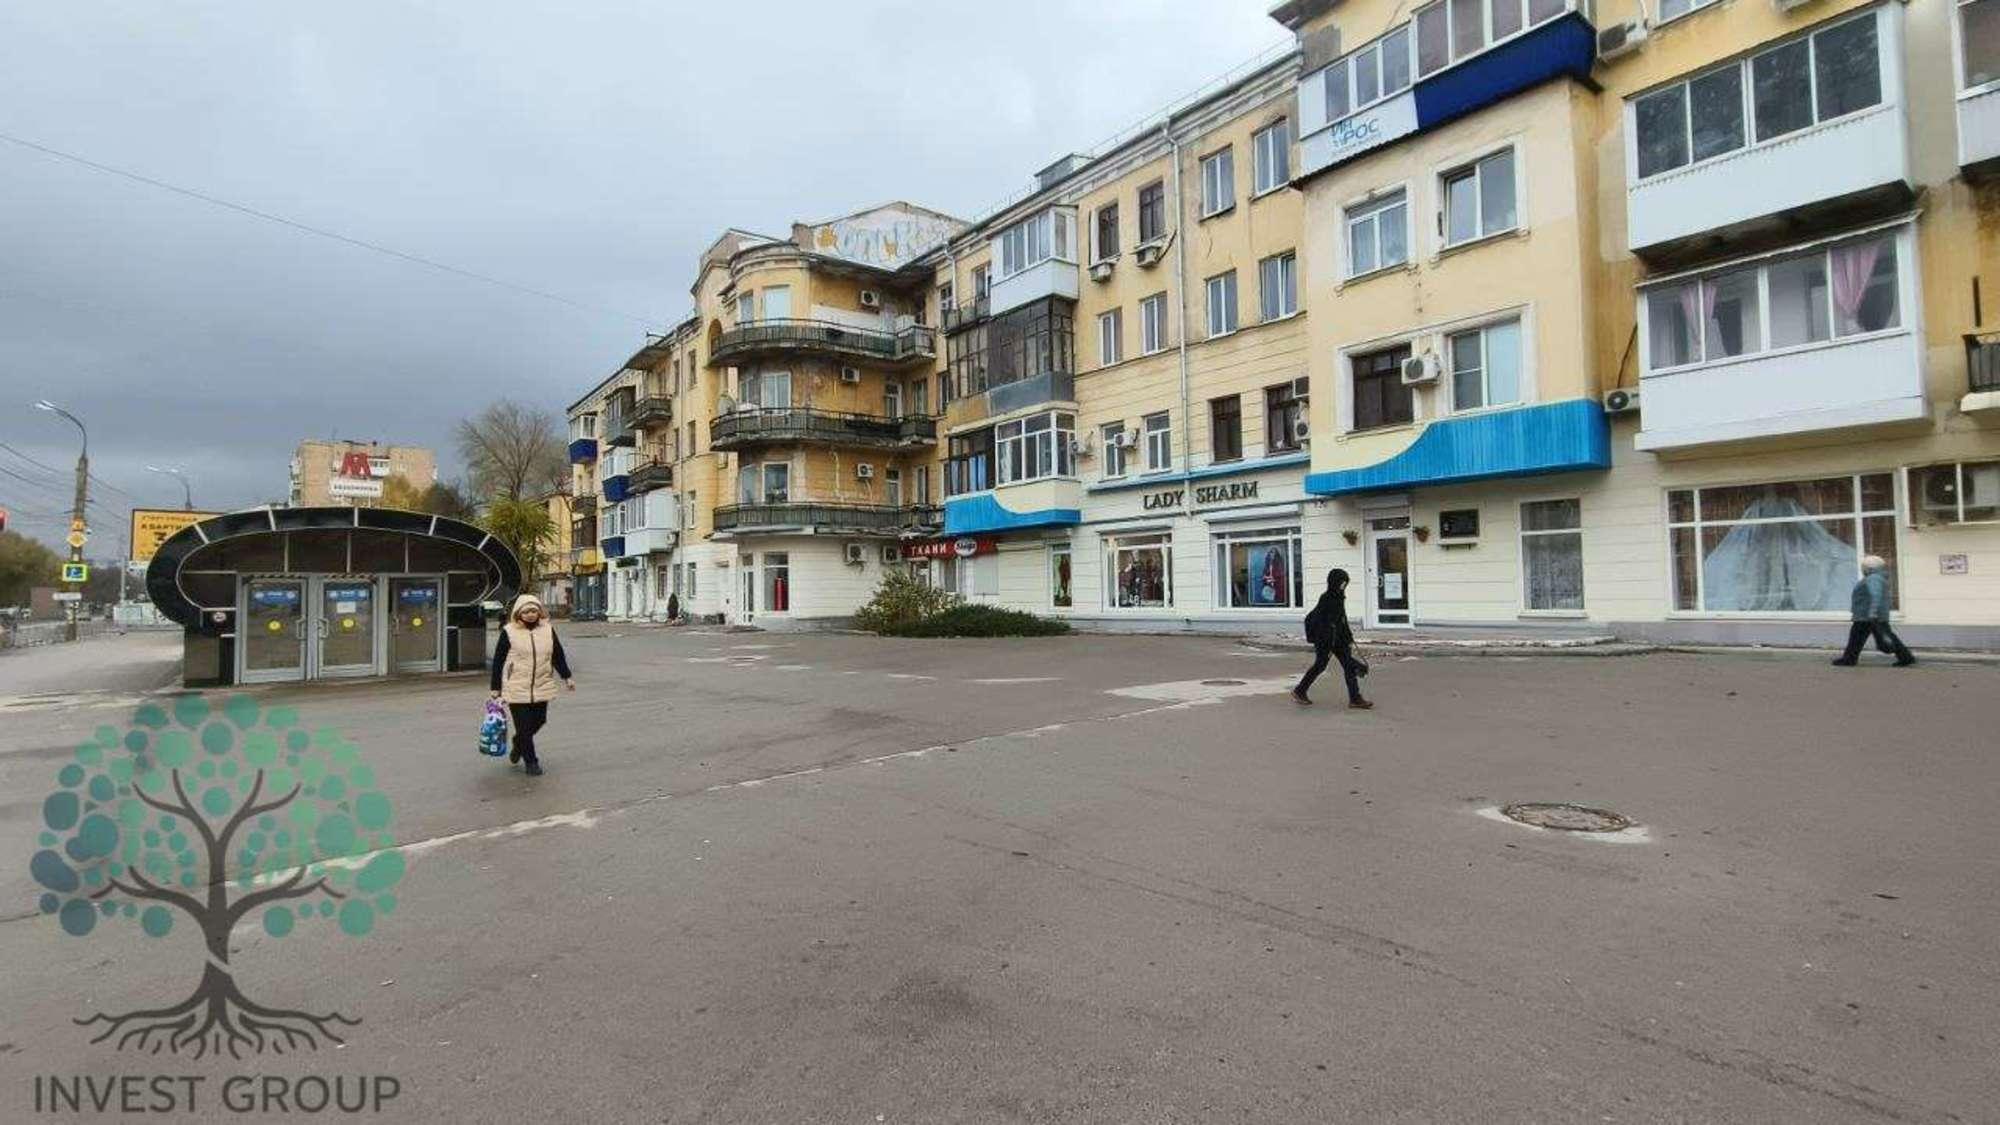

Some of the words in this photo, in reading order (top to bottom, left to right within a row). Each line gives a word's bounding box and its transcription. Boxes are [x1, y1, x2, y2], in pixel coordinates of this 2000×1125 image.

[1143, 489, 1184, 510] LADY
[1196, 480, 1259, 504] SHARM
[911, 543, 947, 556] ТКАНИ
